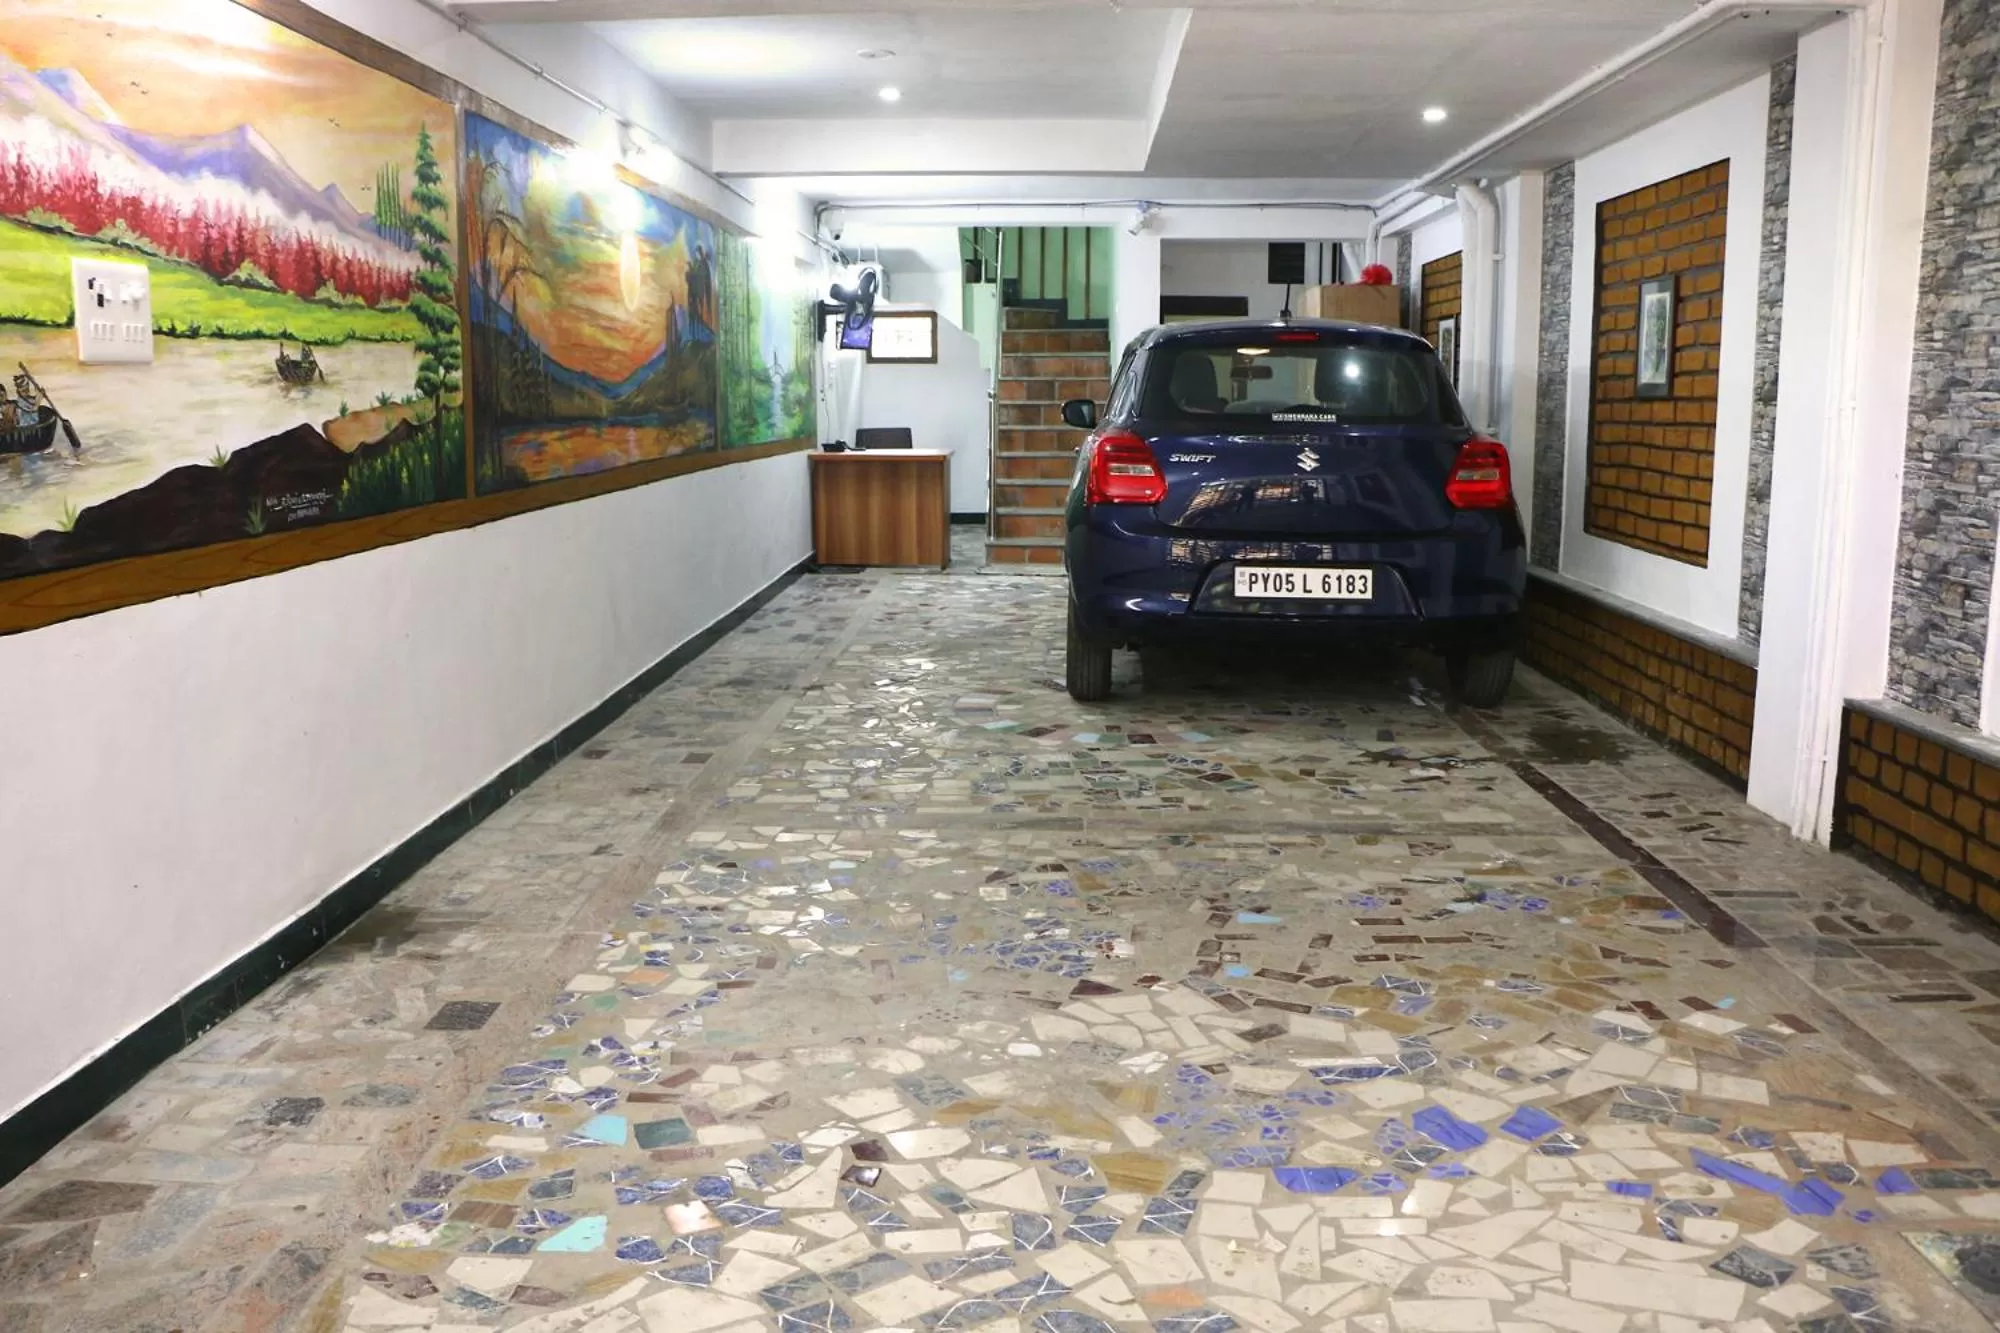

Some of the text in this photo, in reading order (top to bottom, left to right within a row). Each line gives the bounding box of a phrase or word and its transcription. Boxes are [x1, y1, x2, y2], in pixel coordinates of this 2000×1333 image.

[1169, 453, 1217, 463] SWIFT
[1248, 572, 1368, 595] PY05 L 6183
